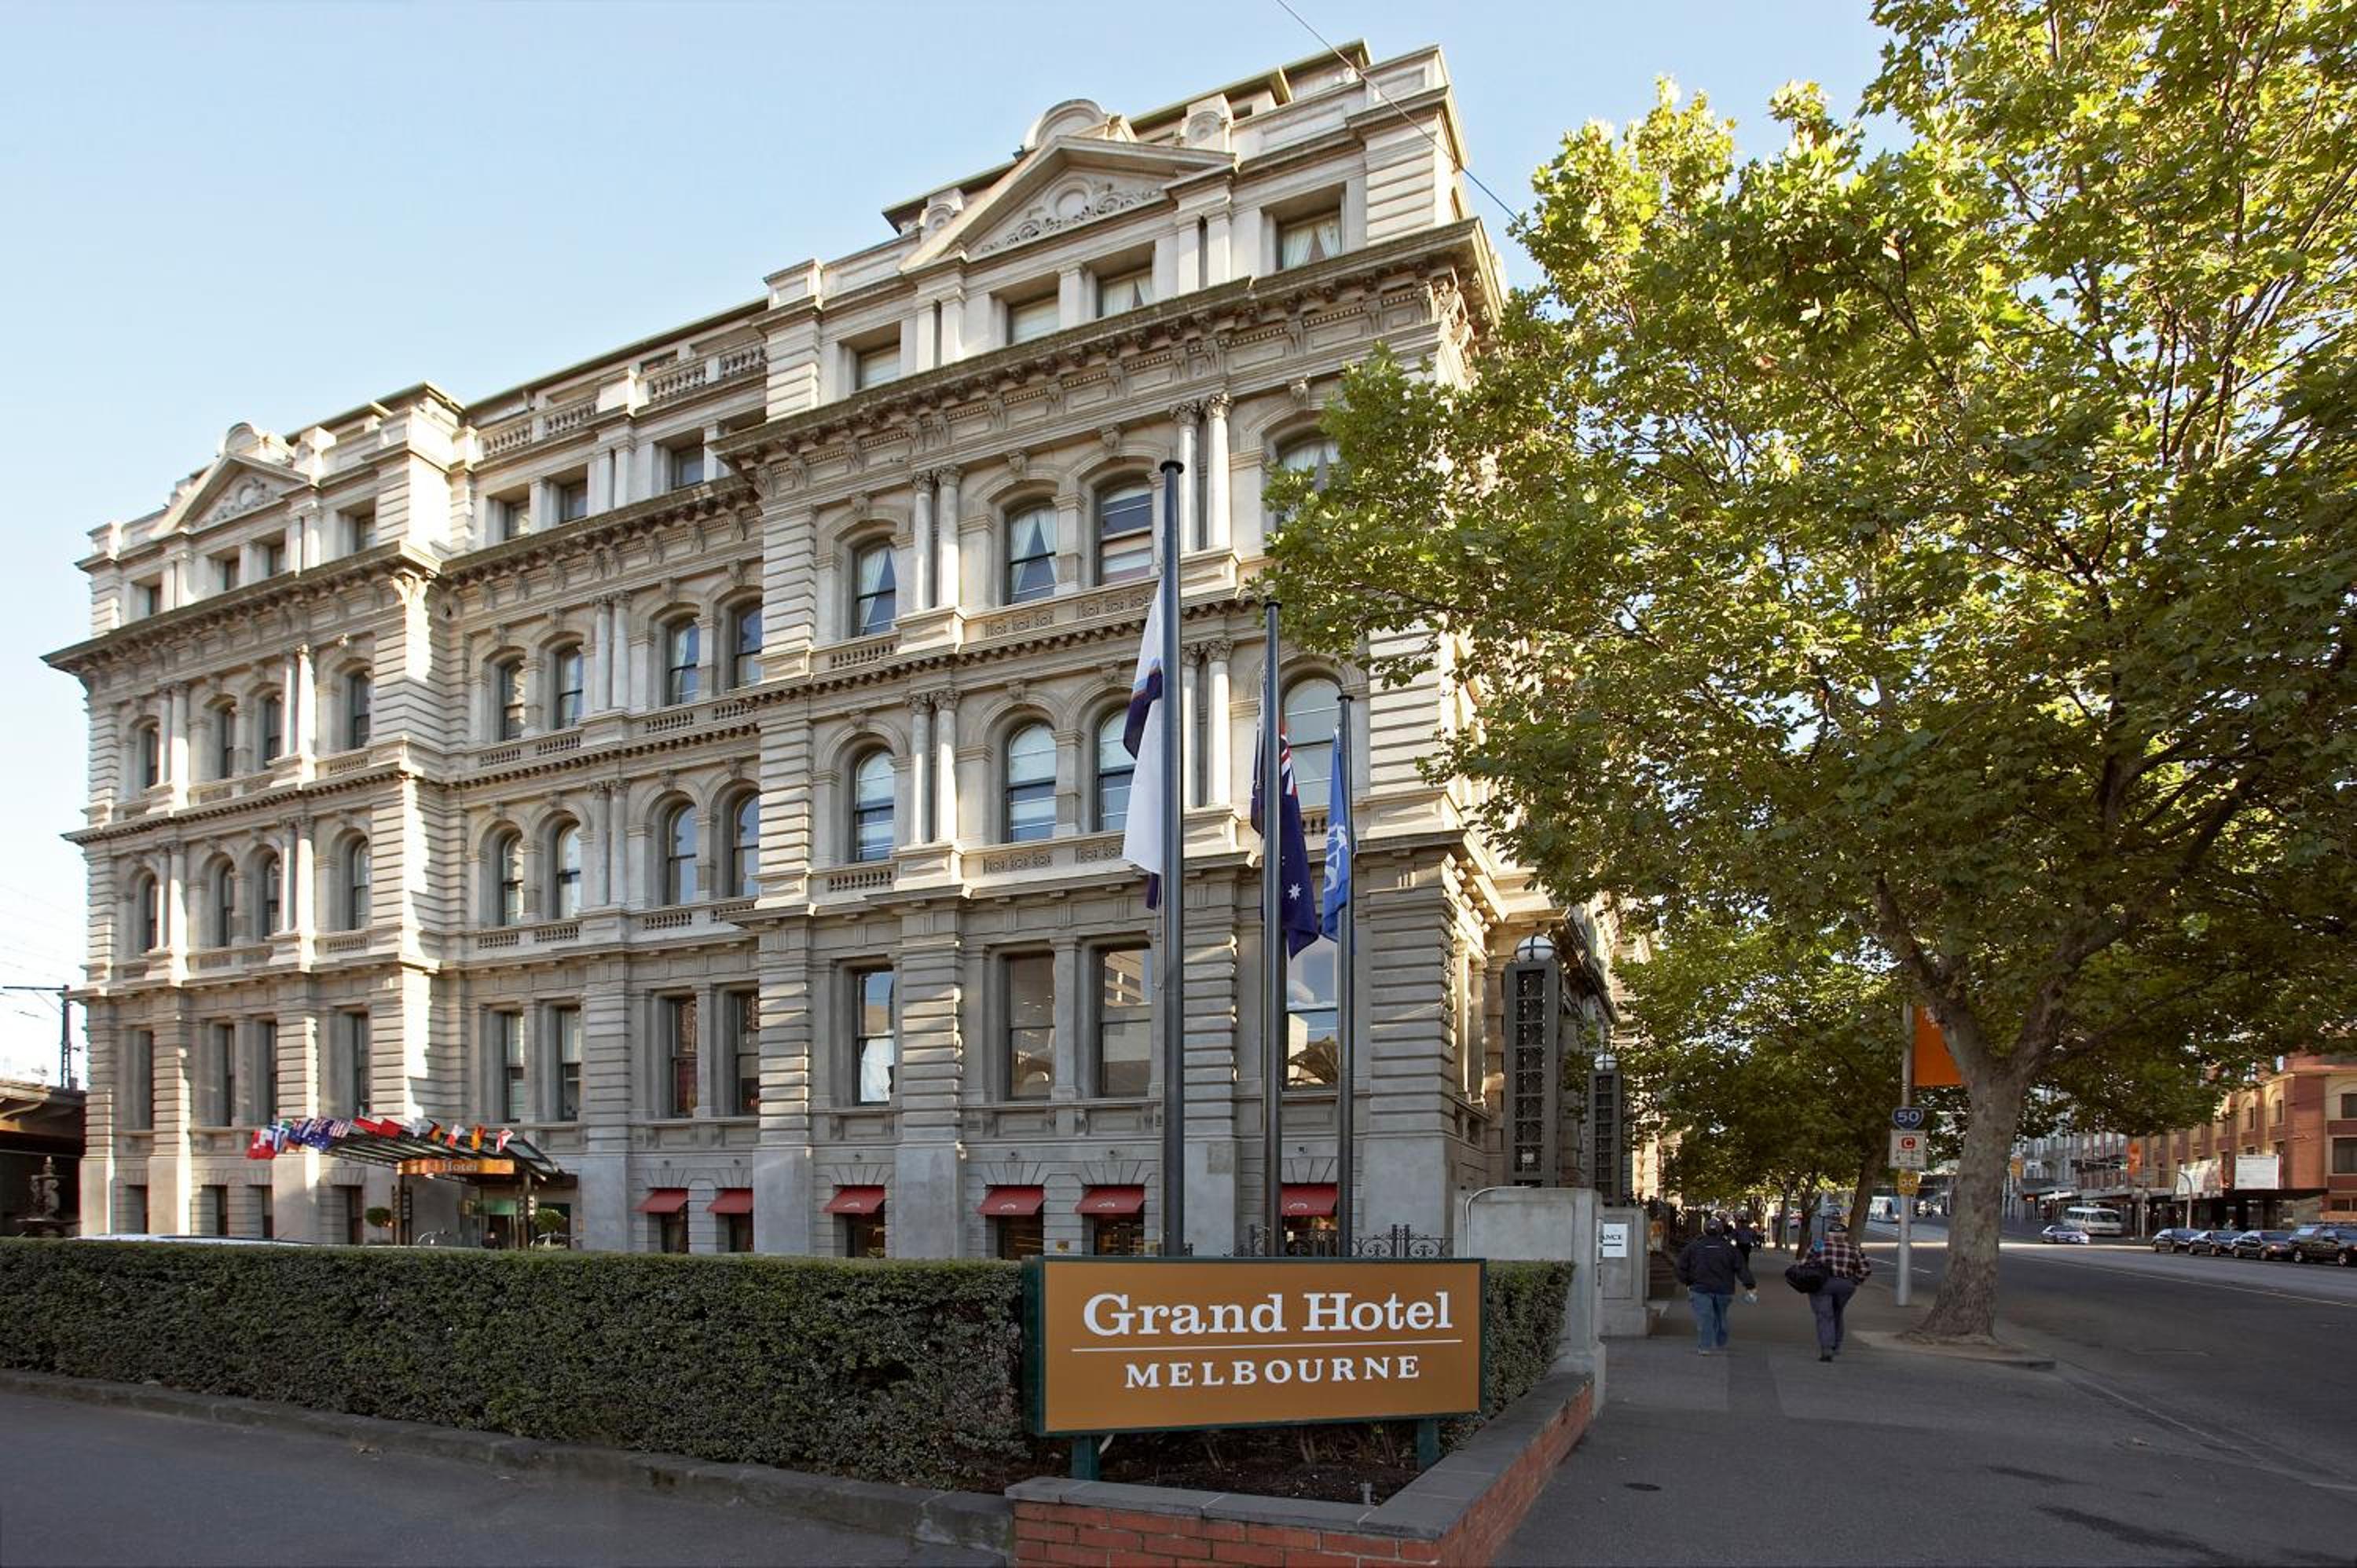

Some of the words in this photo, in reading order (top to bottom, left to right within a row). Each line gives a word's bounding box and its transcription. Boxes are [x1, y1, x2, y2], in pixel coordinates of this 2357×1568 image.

[1897, 1112, 1919, 1123] 50
[442, 1161, 478, 1171] Hotel
[1083, 1292, 1287, 1335] Grand
[1302, 1291, 1453, 1332] Hotel
[1124, 1355, 1420, 1388] MELBOURNE
